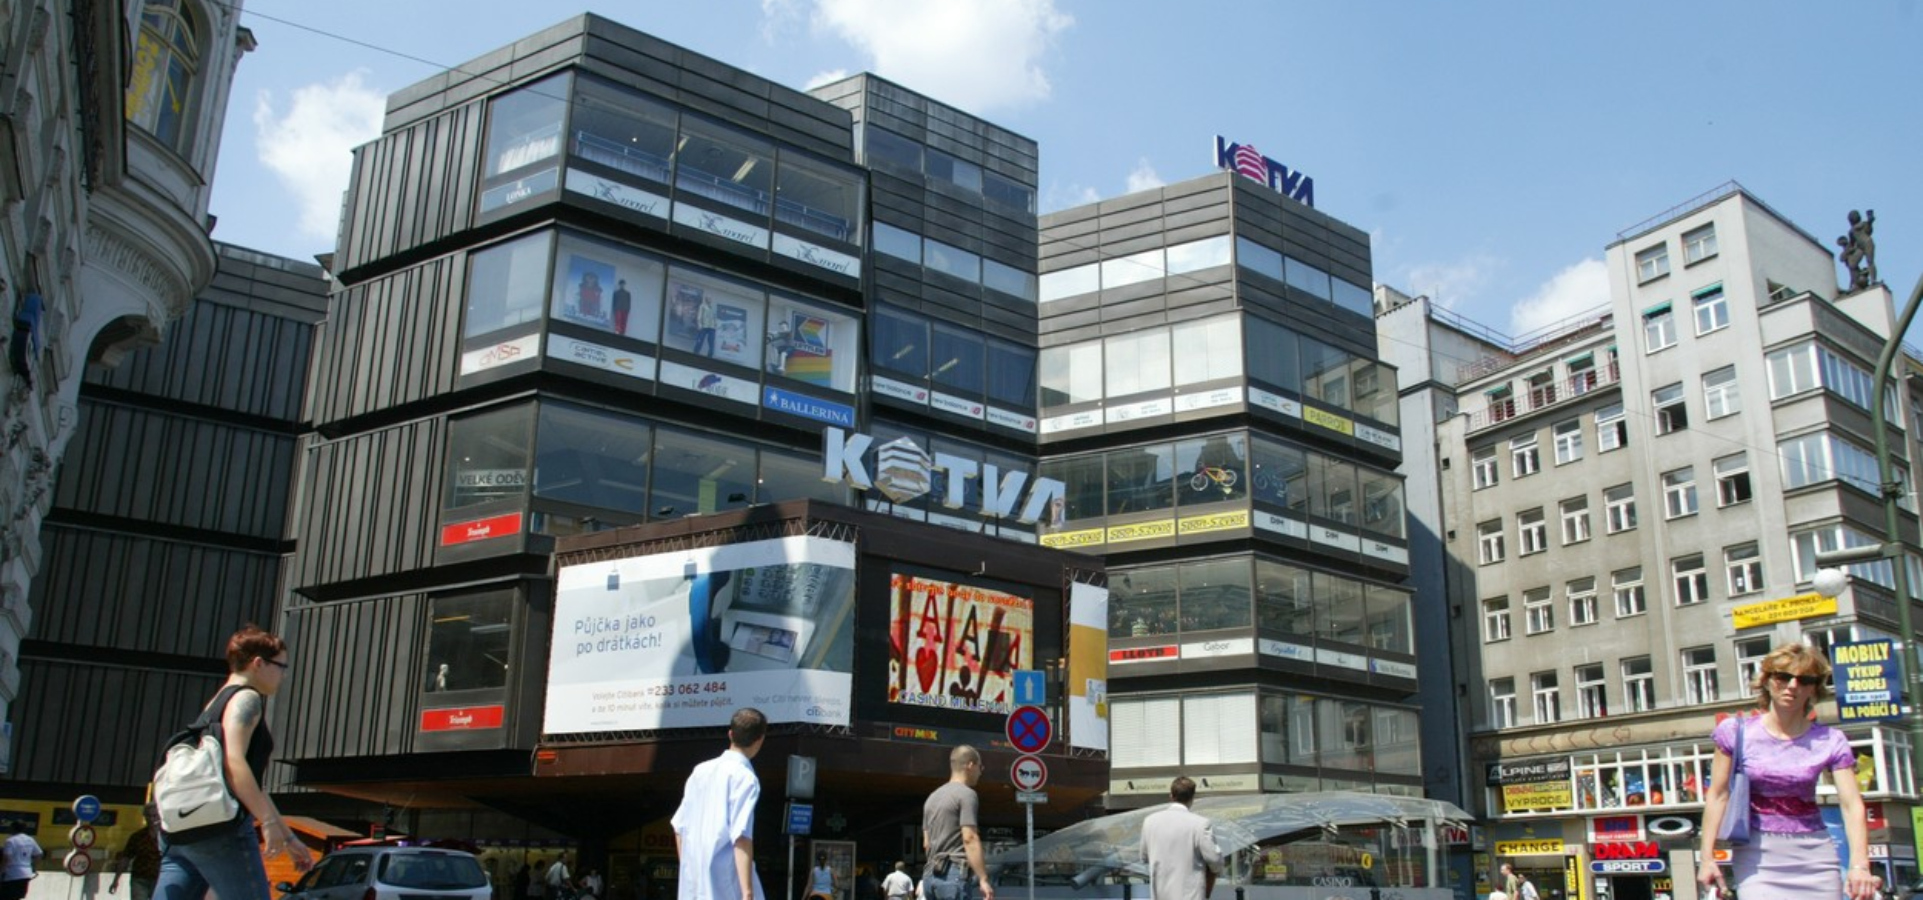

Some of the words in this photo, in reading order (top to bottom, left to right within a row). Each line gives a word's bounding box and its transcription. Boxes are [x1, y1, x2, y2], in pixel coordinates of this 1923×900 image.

[780, 398, 849, 424] BALLERINA
[575, 616, 621, 635] Půjčka
[624, 614, 656, 633] jako
[576, 642, 593, 658] po
[596, 632, 662, 653] drátkách!
[1835, 642, 1890, 665] MOBILY
[1847, 663, 1883, 679] VÝKUP
[654, 685, 675, 696] 233
[678, 683, 700, 695] 062
[704, 681, 726, 693] 484
[1847, 677, 1887, 691] PRODEJ
[900, 689, 947, 706] CASINO
[1841, 706, 1856, 719] NA
[1507, 795, 1570, 807] VYPRODEJ
[1497, 841, 1561, 854] CHANGE
[1602, 862, 1650, 872] SPORT
[1312, 876, 1352, 887] CASINO
